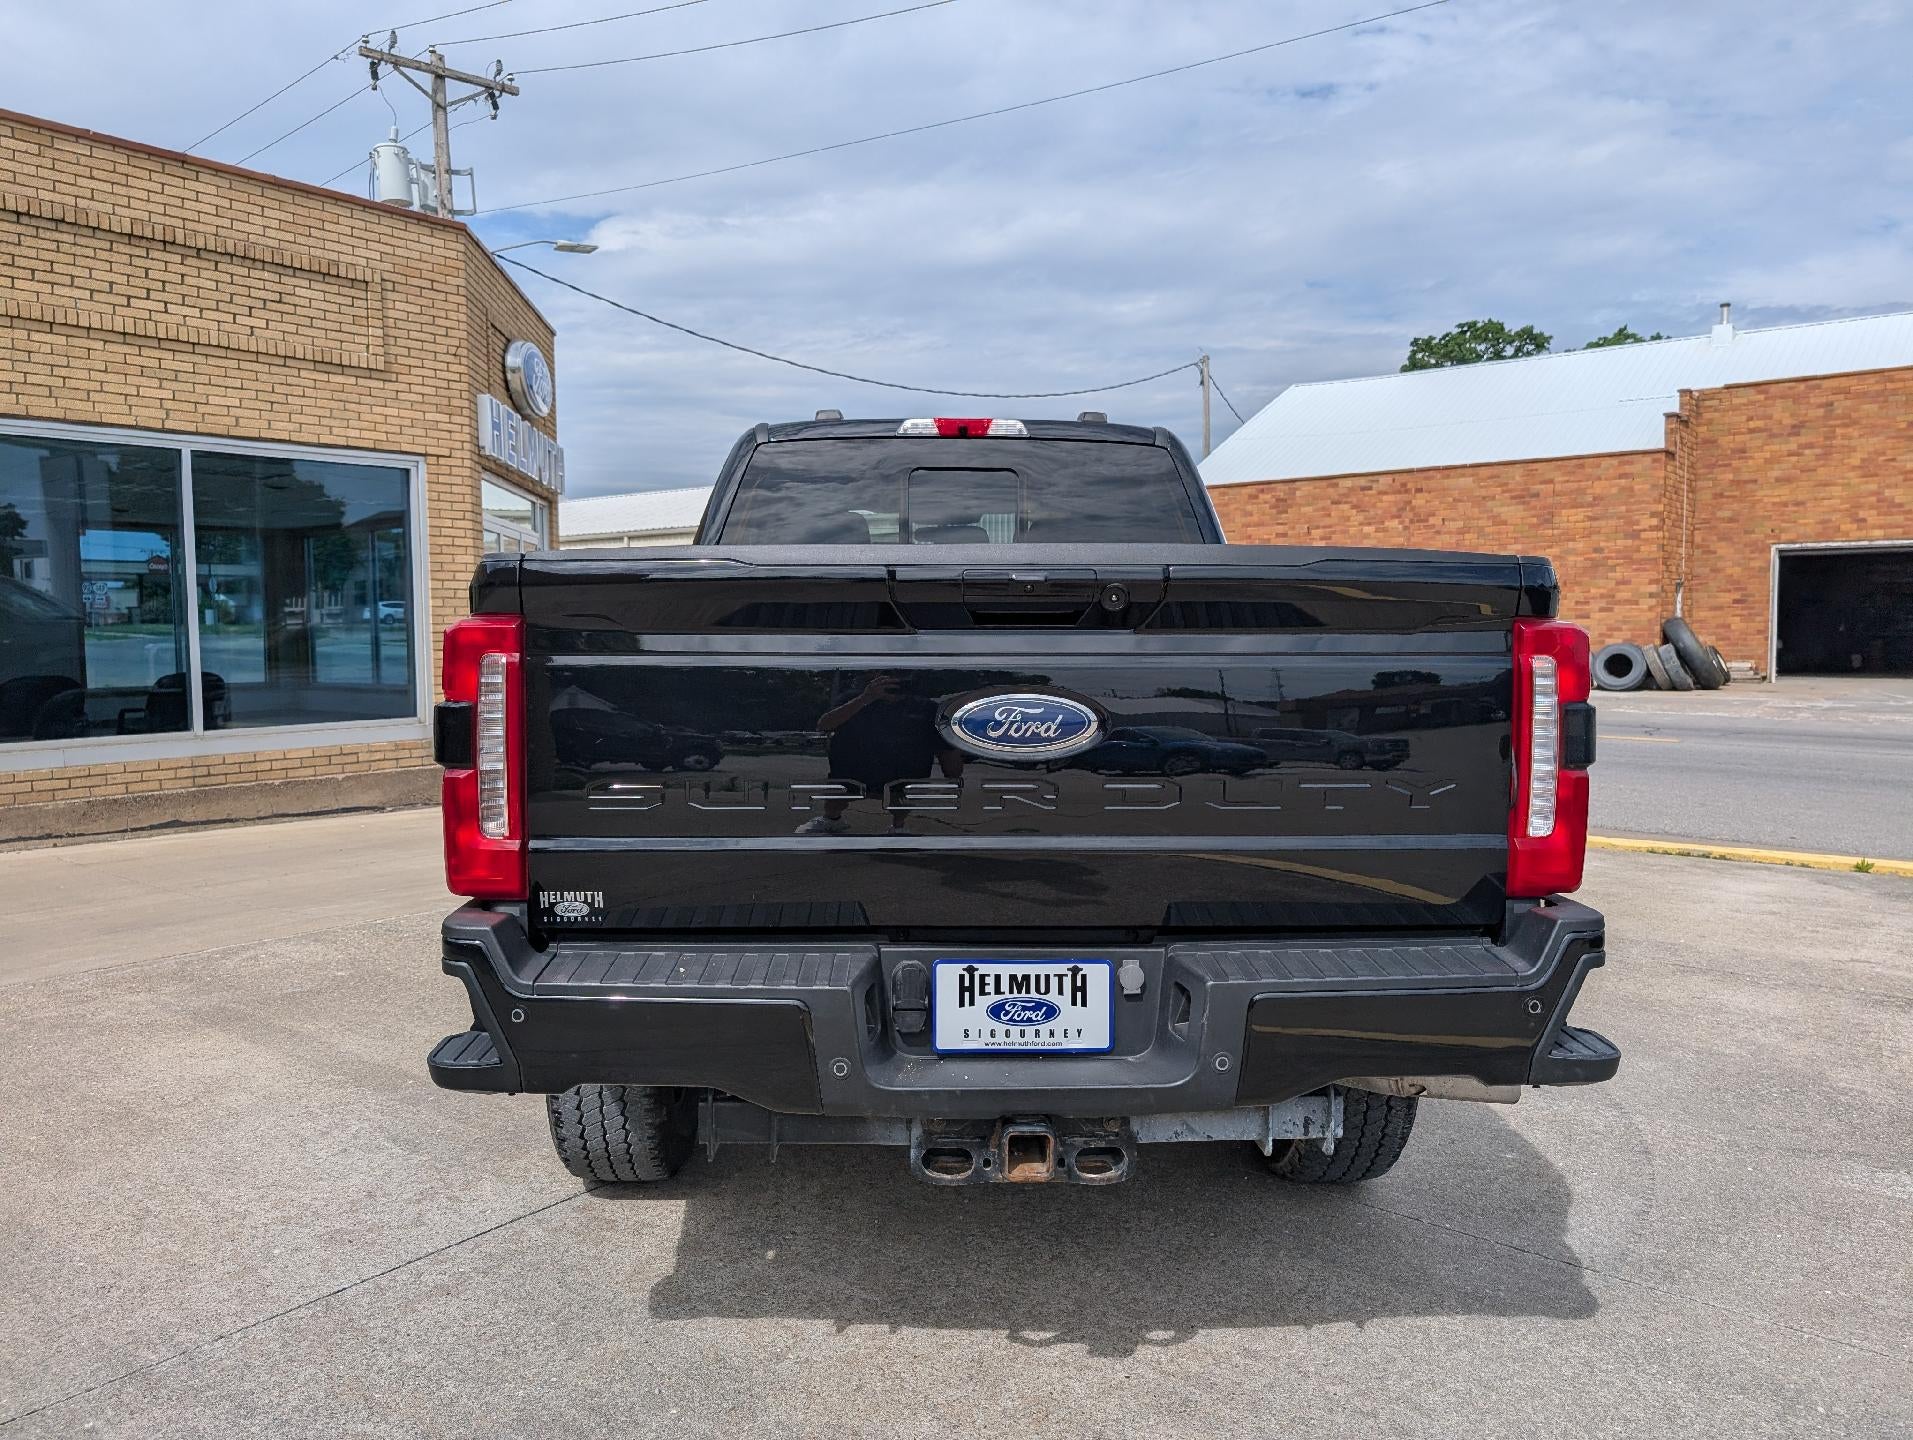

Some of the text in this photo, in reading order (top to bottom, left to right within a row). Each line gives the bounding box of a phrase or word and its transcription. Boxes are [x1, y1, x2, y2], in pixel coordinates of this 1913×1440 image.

[486, 396, 565, 495] HELMUTH
[987, 706, 1063, 738] Ford
[586, 778, 1457, 810] SUPER DUTY
[539, 891, 604, 908] HELMUTH
[560, 904, 584, 914] Ford
[958, 973, 1088, 1008] HELMUTH
[1000, 1001, 1046, 1021] Ford
[963, 1028, 1083, 1039] SIGOURNEY
